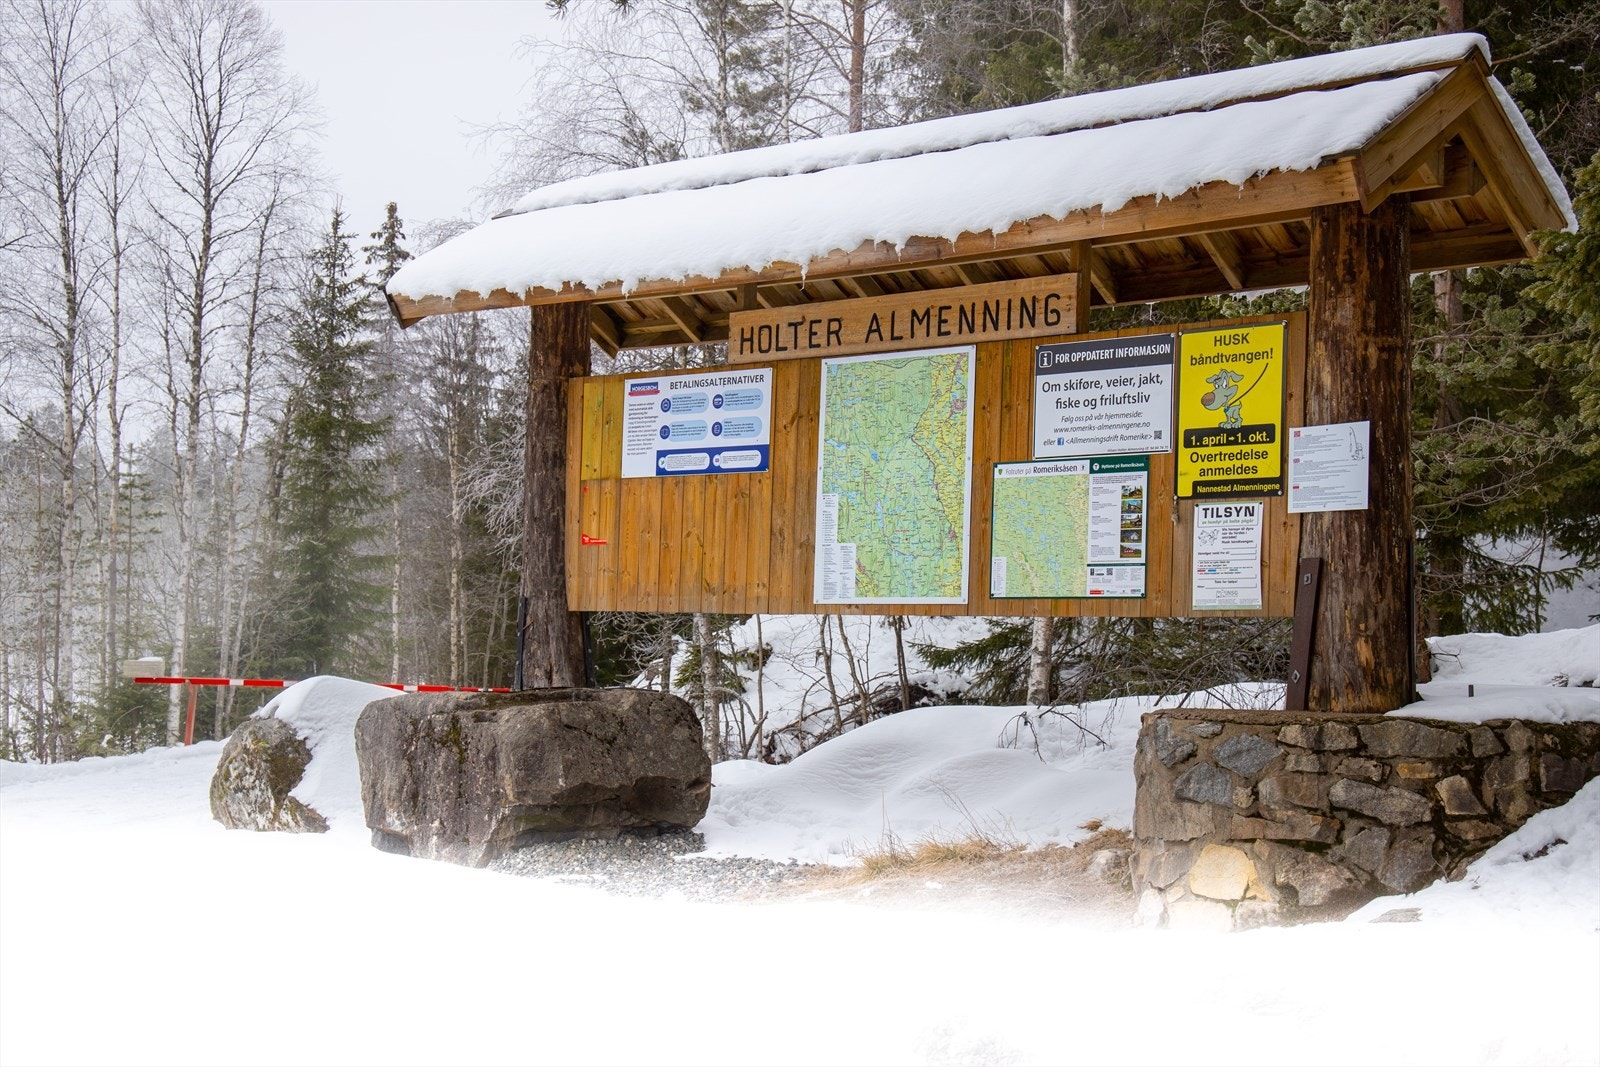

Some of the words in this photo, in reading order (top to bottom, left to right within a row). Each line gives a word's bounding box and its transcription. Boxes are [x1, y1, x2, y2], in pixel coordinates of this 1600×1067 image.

[739, 317, 842, 356] HOLTER
[864, 293, 1062, 344] ALMENNING
[1213, 332, 1250, 347] HUSK
[1055, 353, 1070, 364] FOR
[1070, 348, 1115, 363] OPPDATERT
[1115, 343, 1171, 359] INFORMASJON
[1189, 347, 1274, 366] båndtvangen!
[669, 374, 765, 390] BETALINGSALTERNATIVER
[1042, 381, 1061, 393] Om
[1063, 378, 1103, 392] skiføre,
[1105, 375, 1136, 389] veier,
[1137, 373, 1163, 389] jakt,
[1055, 397, 1080, 410] fiske
[1083, 399, 1097, 410] og
[1100, 392, 1151, 407] friluftsliv
[1061, 415, 1074, 424] Følg
[1084, 415, 1093, 423] på
[1104, 411, 1143, 422] hjemmeside:
[1190, 435, 1200, 446] 1.
[1202, 433, 1227, 447] april
[1236, 433, 1246, 444] 1.
[1248, 431, 1270, 443] okt.
[1189, 449, 1269, 464] Overtredelse
[1033, 465, 1078, 474] Romeriksåsen
[1199, 463, 1259, 477] anmeldes
[1197, 484, 1232, 493] Nannestad
[1232, 482, 1281, 493] Almenningene
[1202, 506, 1255, 518] TILSYN
